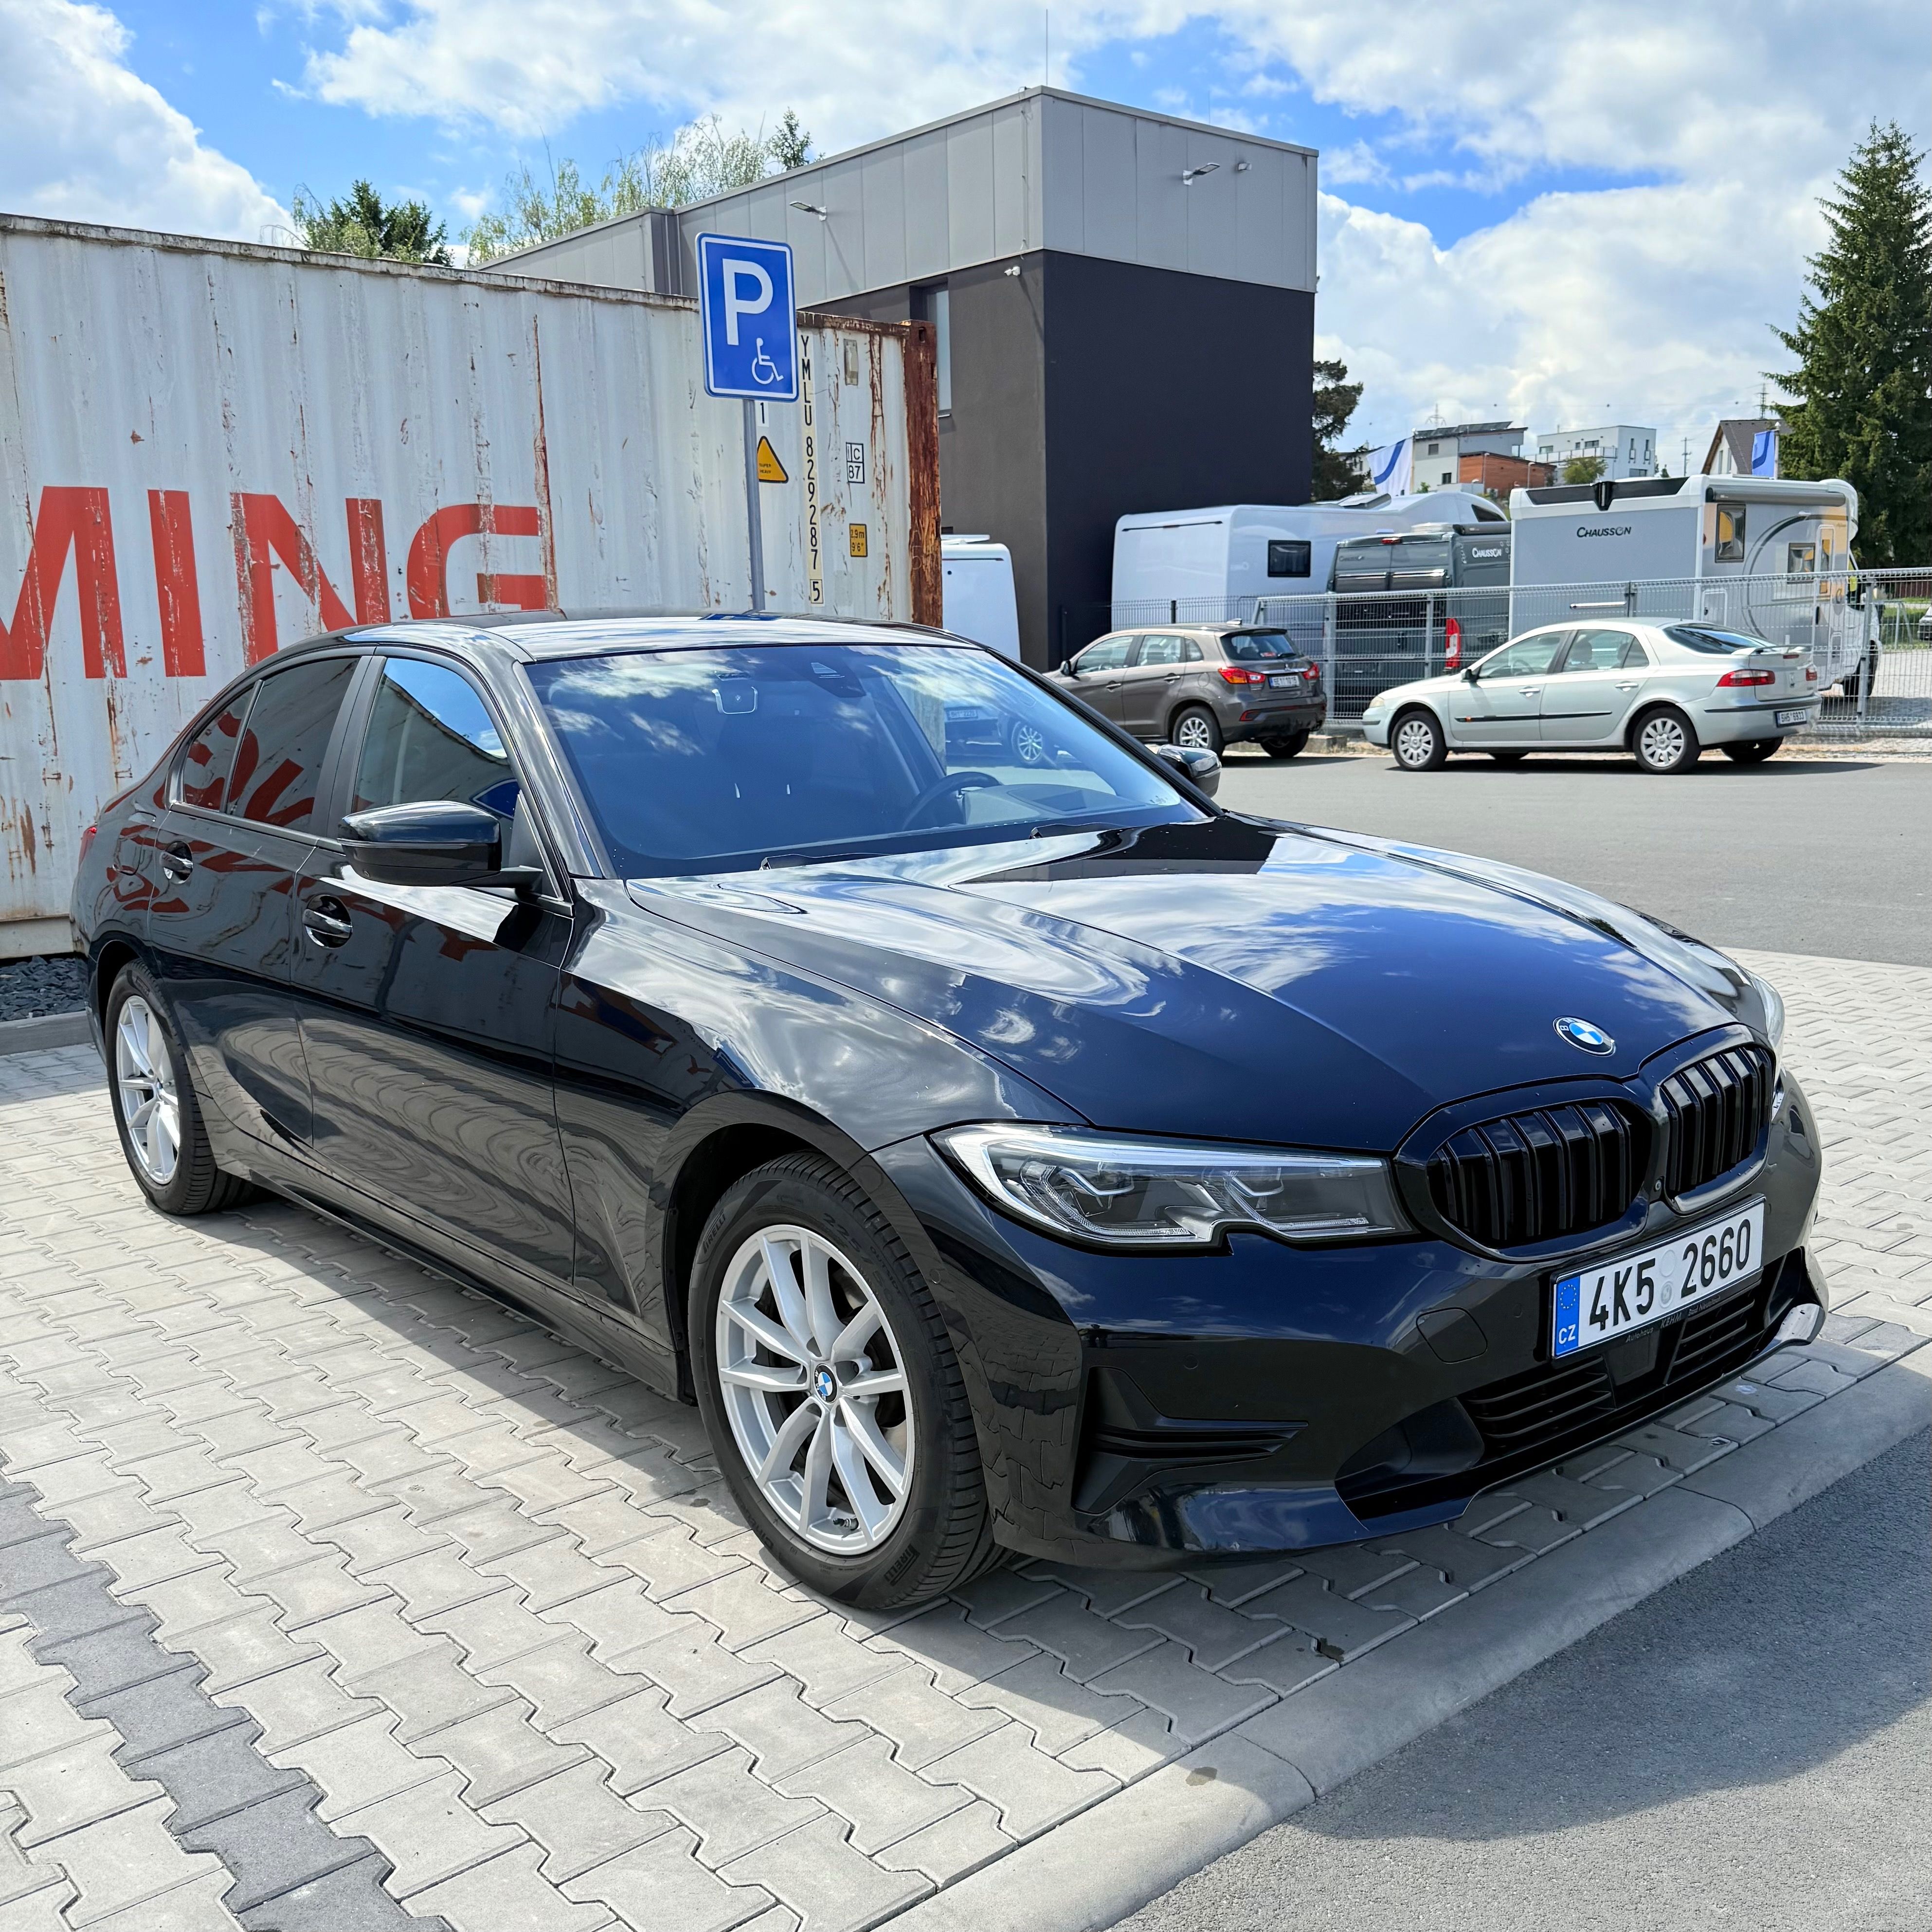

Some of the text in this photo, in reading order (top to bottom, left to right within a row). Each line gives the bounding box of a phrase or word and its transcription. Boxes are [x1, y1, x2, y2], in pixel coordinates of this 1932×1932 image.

[722, 258, 773, 345] P
[800, 335, 820, 603] YMLU 829287 5
[849, 465, 861, 479] 87
[1577, 527, 1631, 538] CHAUSSON
[703, 1208, 726, 1255] PIRELLI
[1589, 1219, 1751, 1331] 4K5 2660
[1558, 1324, 1576, 1344] CZ
[884, 1542, 921, 1587] PIRELLI
